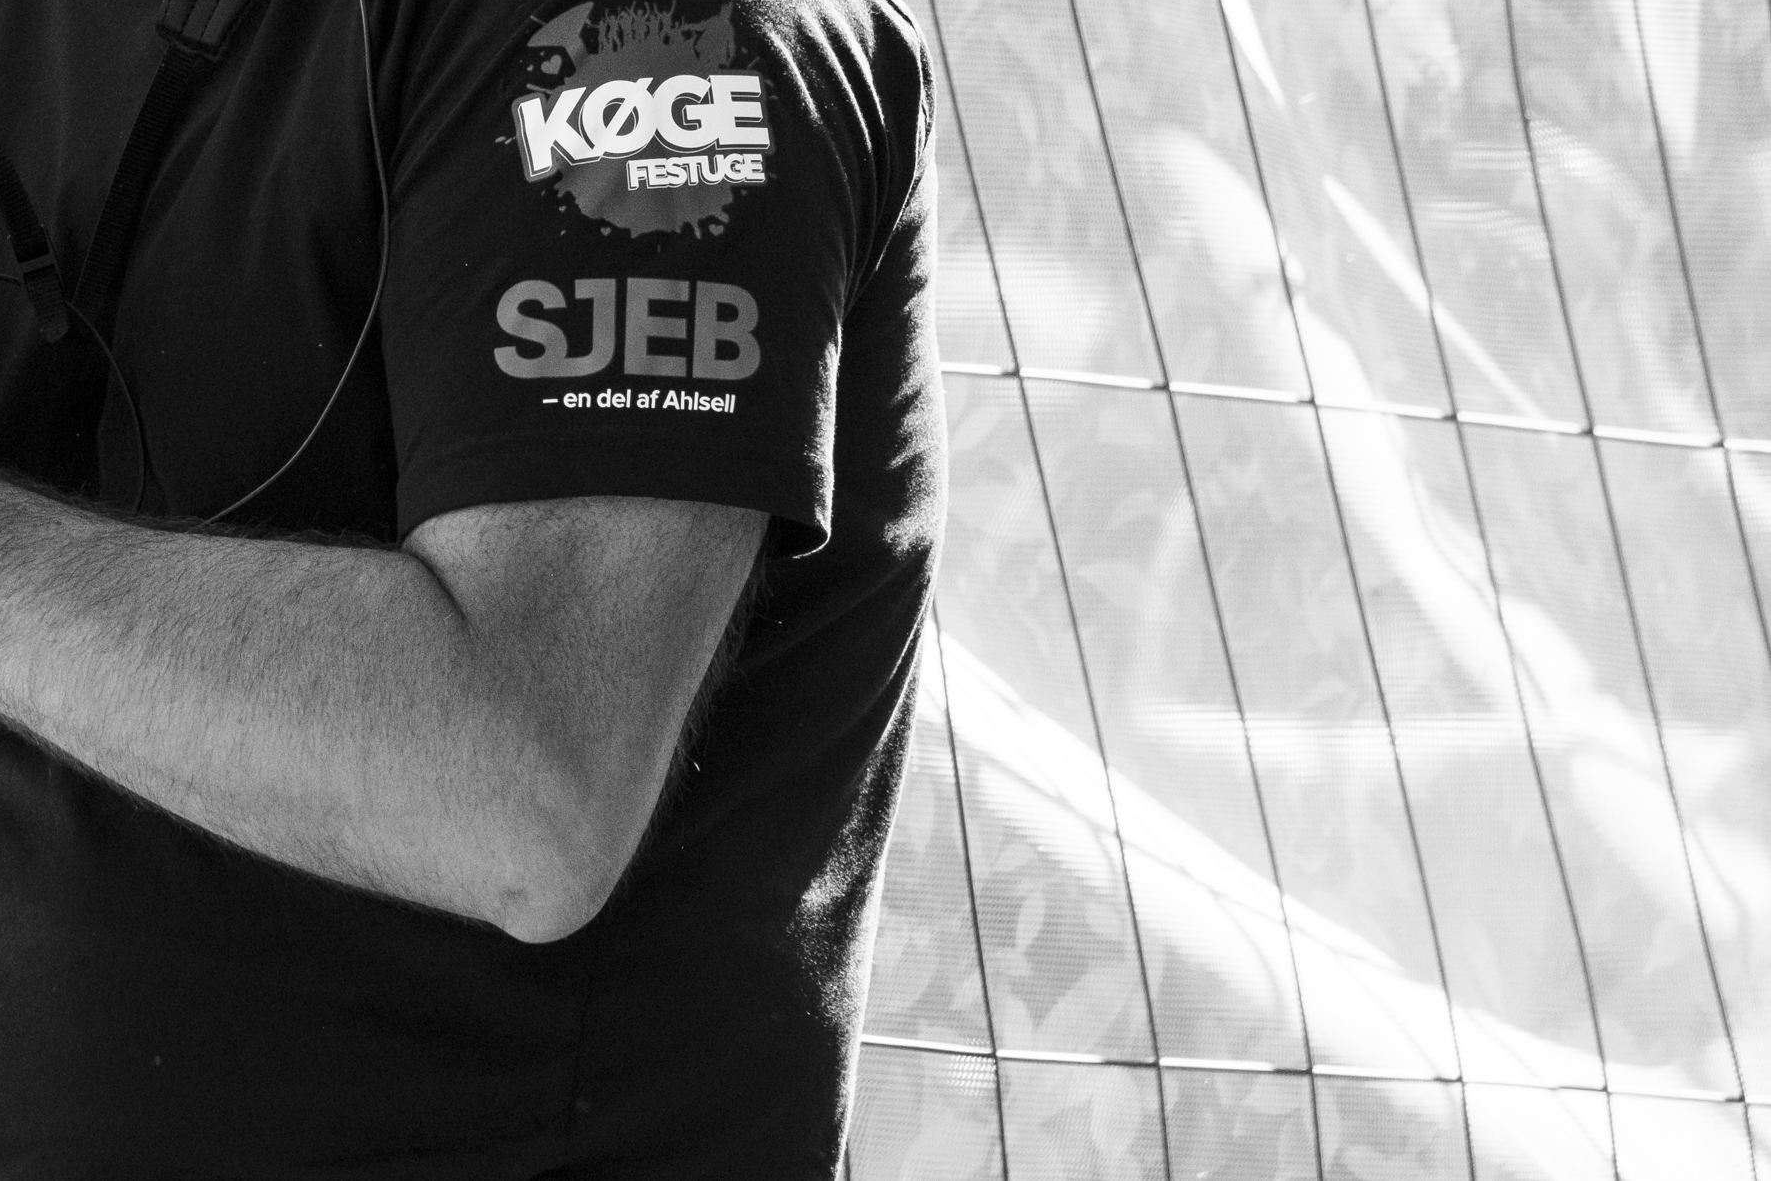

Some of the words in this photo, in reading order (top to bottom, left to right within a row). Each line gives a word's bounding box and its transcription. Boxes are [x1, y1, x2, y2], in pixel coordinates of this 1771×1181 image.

[517, 74, 771, 177] KØGE
[627, 153, 766, 191] FESTUGE
[493, 277, 761, 381] SJEB
[563, 391, 591, 408] en
[596, 389, 632, 408] del
[636, 389, 661, 409] af
[663, 390, 736, 414] Ahlsell
